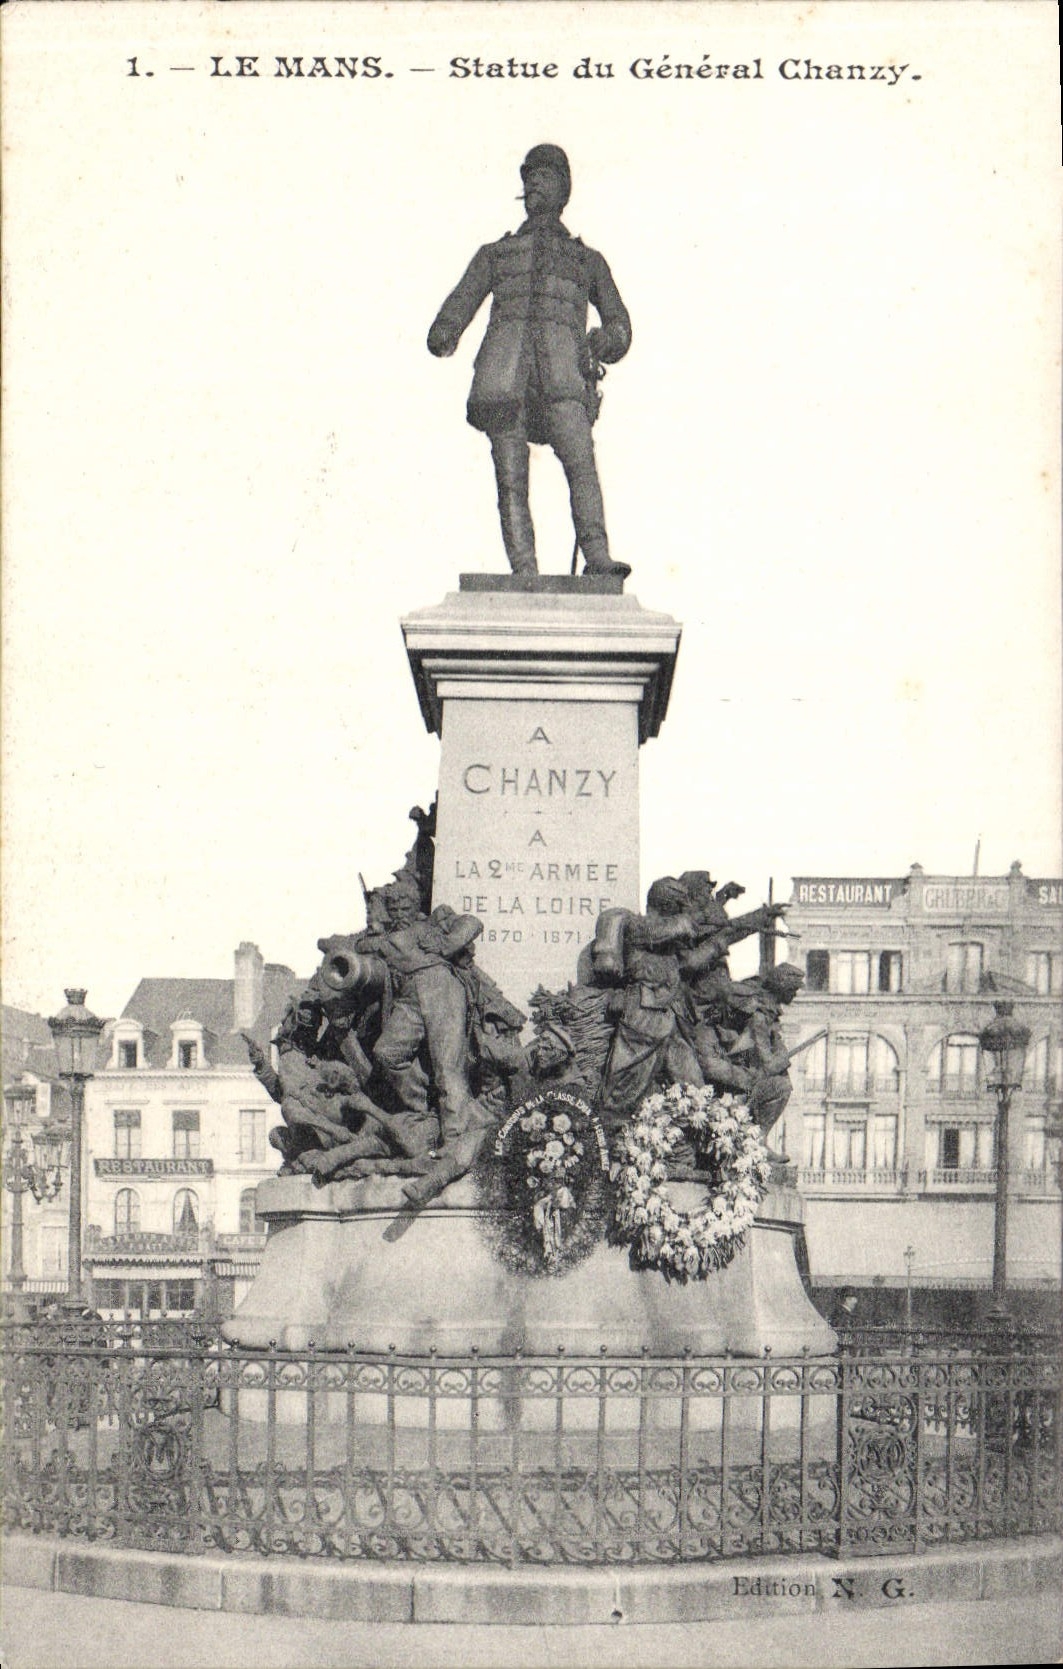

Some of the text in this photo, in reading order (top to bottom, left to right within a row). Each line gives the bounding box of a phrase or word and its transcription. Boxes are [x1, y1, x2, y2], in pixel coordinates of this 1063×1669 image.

[528, 726, 551, 744] A
[463, 764, 616, 797] CHANZY
[528, 830, 547, 847] A
[455, 861, 481, 879] LA
[800, 884, 892, 904] RESTAURANT
[462, 896, 488, 913] DE
[499, 896, 524, 915] LA
[480, 930, 581, 944] 1870 1871
[98, 1160, 209, 1175] RESTAURANT
